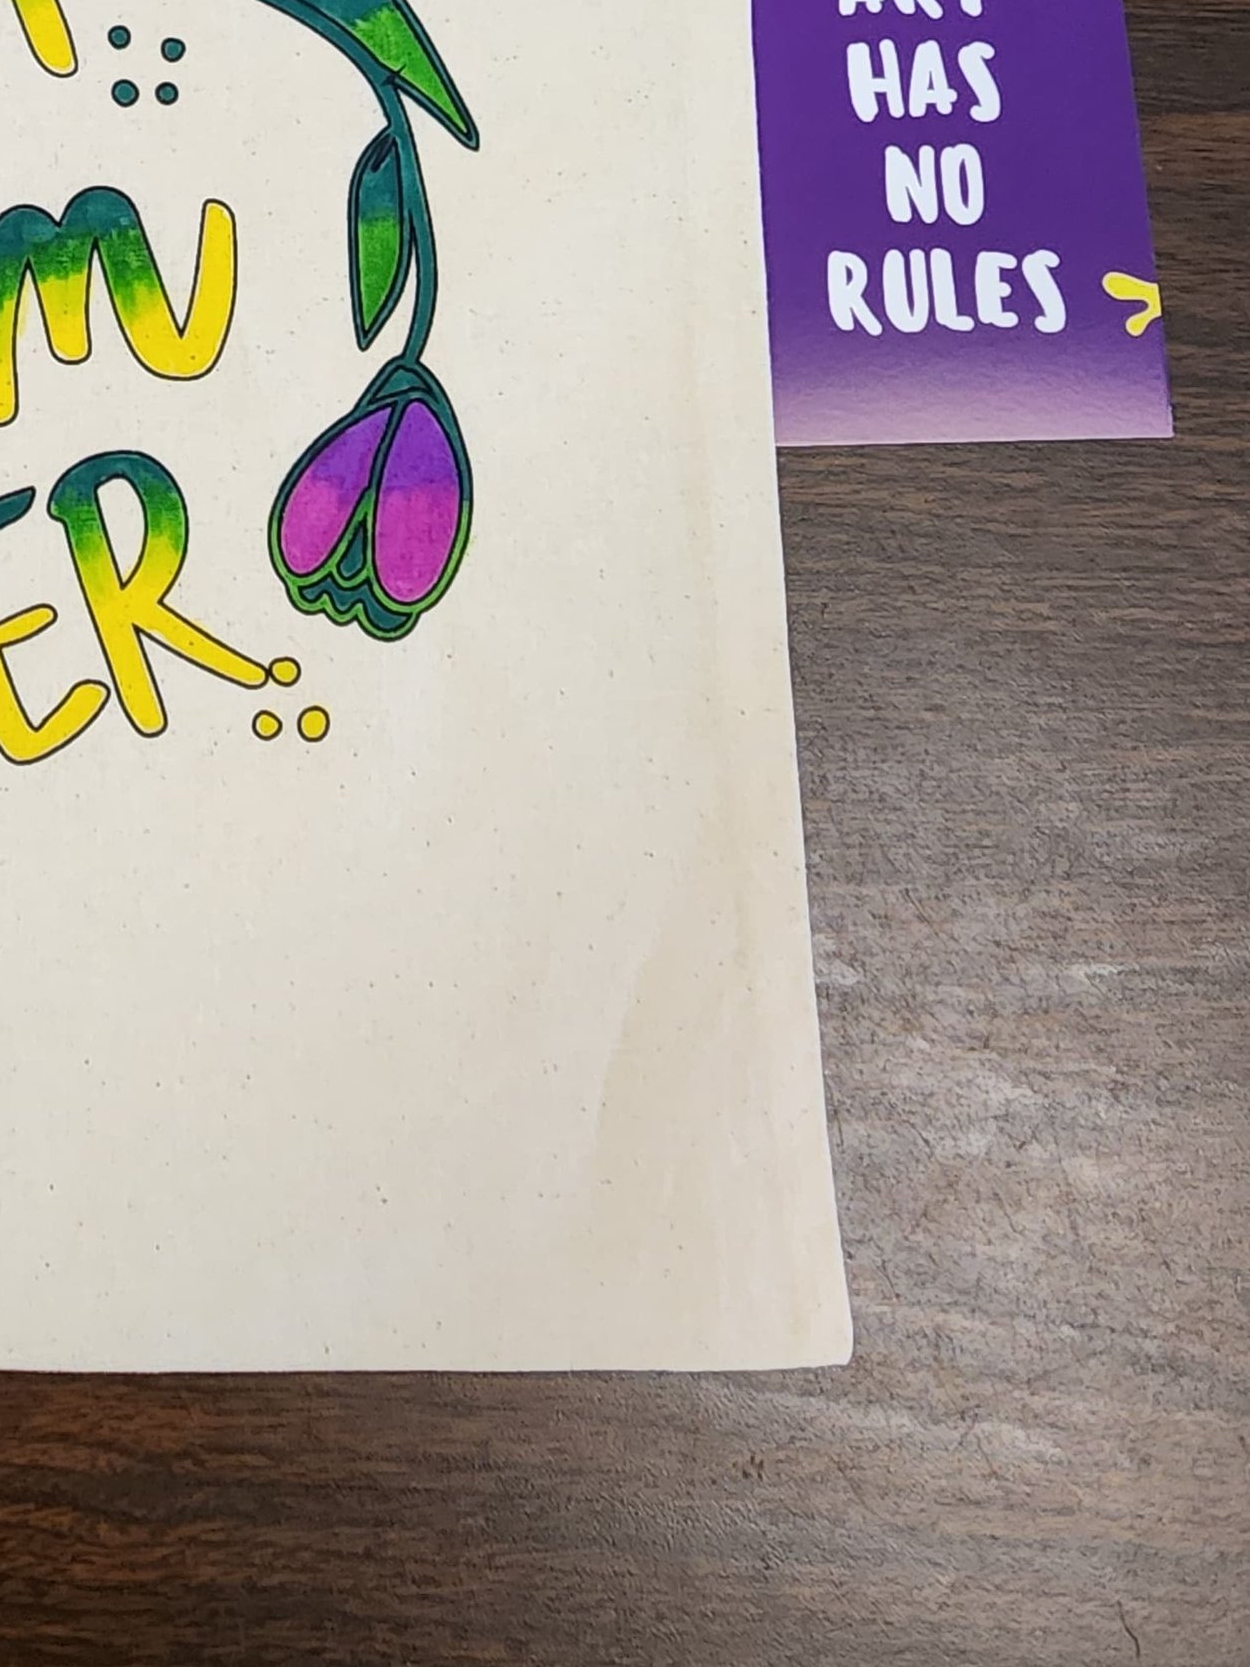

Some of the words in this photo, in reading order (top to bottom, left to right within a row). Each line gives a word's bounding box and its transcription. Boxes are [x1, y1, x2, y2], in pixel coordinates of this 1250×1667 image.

[847, 38, 1002, 123] HAS
[884, 143, 984, 225] NO
[827, 248, 1067, 335] RULES
